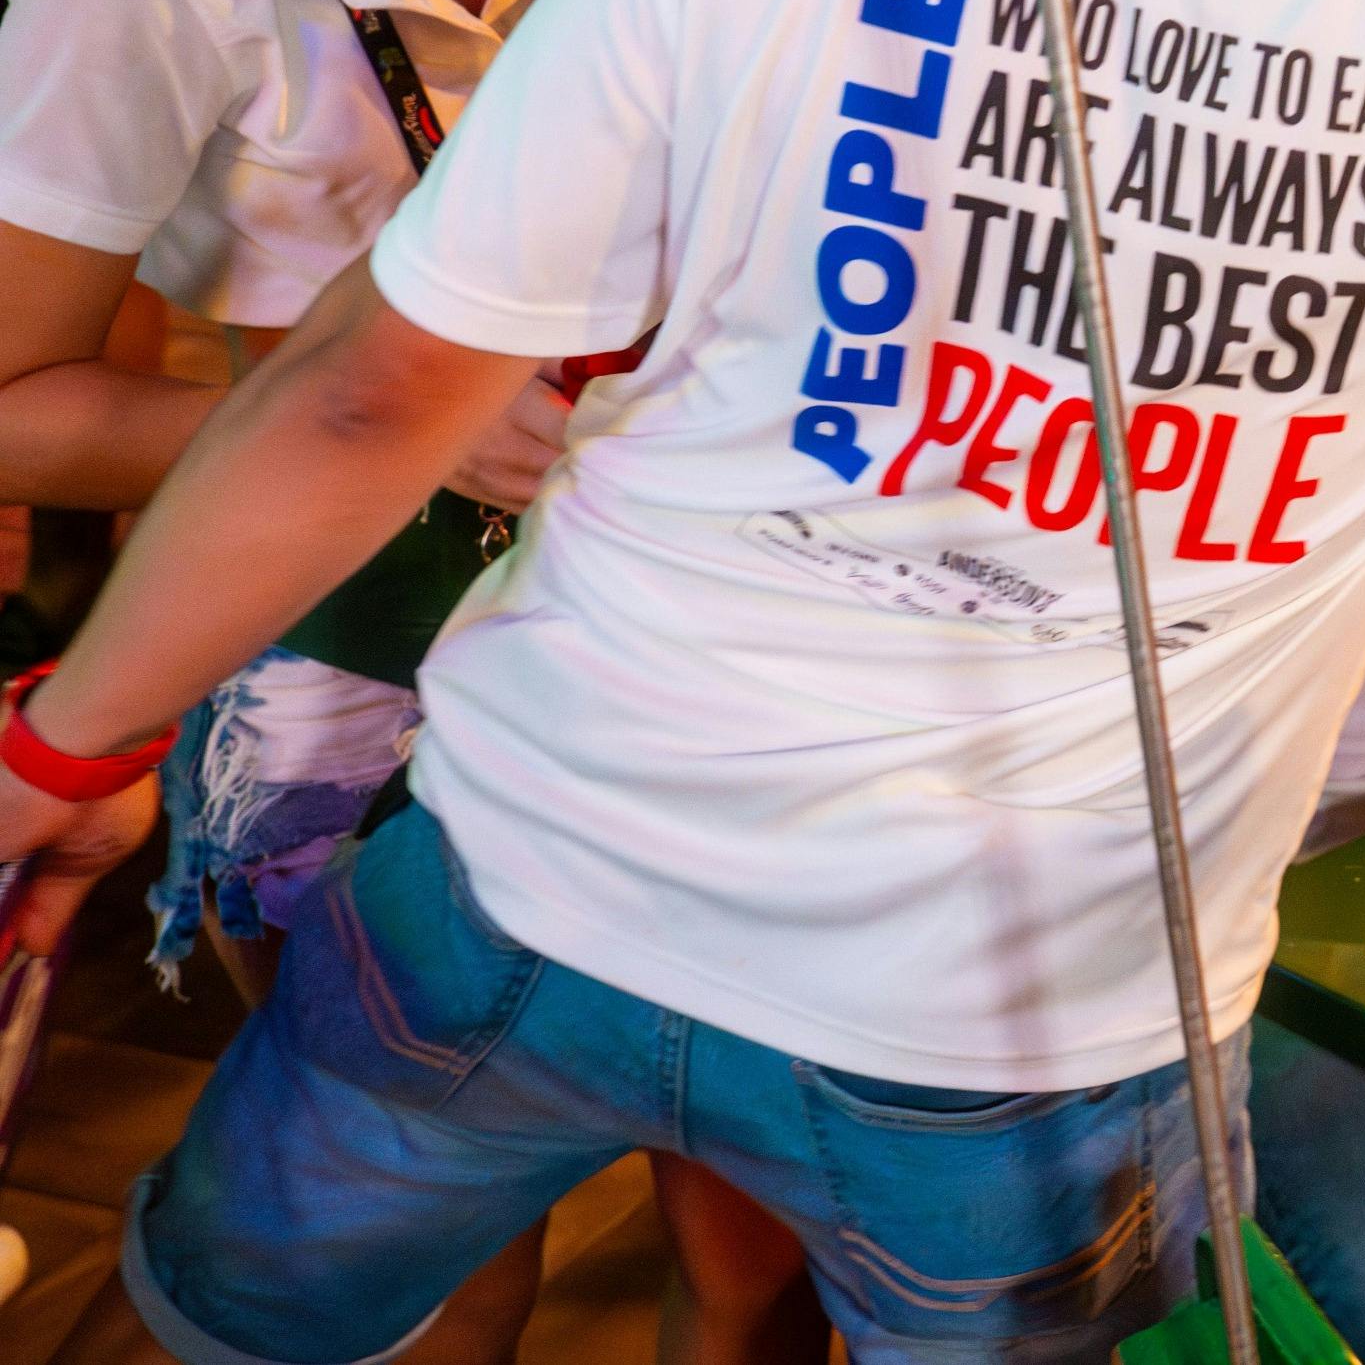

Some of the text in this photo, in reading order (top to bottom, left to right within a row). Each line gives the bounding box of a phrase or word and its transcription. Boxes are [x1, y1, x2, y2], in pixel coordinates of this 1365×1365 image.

[1123, 5, 1240, 113] LOVE
[1248, 41, 1314, 127] TO
[958, 69, 1109, 189] AR
[876, 339, 1348, 567] PEOPLE
